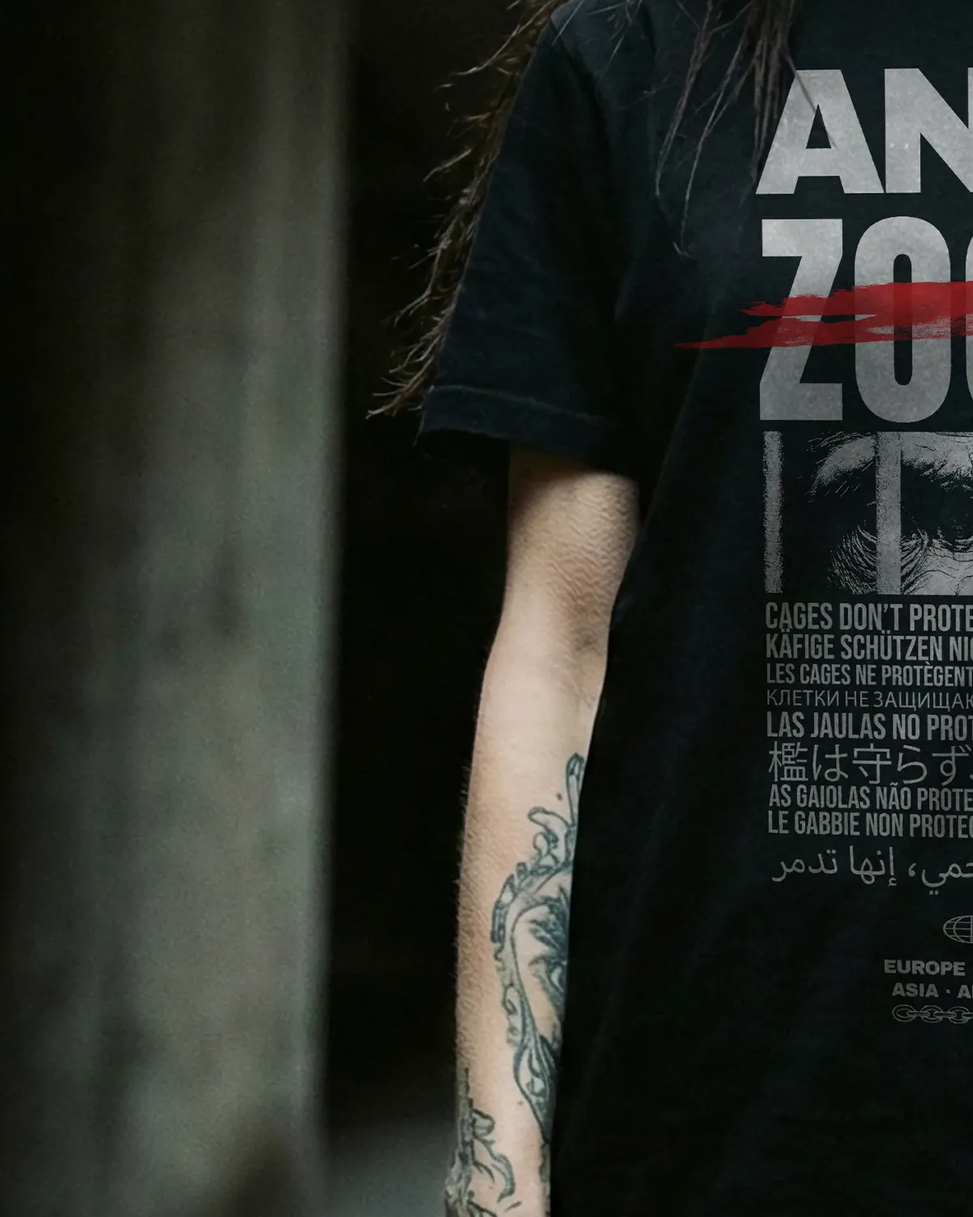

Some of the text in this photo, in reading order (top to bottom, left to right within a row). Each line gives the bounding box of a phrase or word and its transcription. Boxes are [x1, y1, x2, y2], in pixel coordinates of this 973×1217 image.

[765, 602, 833, 630] CAGES
[839, 603, 903, 631] DON'T
[766, 628, 834, 659] KÄFIGE
[840, 630, 942, 661] SCHÜTZEN
[766, 663, 795, 684] LES
[799, 663, 851, 685] CAGES
[856, 664, 877, 686] NE
[767, 689, 839, 707] КЛЕТКИ
[845, 691, 869, 708] НЕ
[766, 711, 805, 738] LAS
[810, 712, 886, 740] JAULAS
[892, 713, 921, 740] NO
[769, 784, 792, 808] AS
[796, 784, 870, 809] GAIOLAS
[876, 781, 911, 810] NÃO
[768, 810, 789, 834] LE
[794, 811, 860, 836] GABBIE
[866, 812, 904, 837] NON
[771, 848, 838, 882] تدمر
[849, 845, 897, 887] إنها
[884, 959, 966, 976] EUROPE
[892, 982, 939, 998] ASIA
